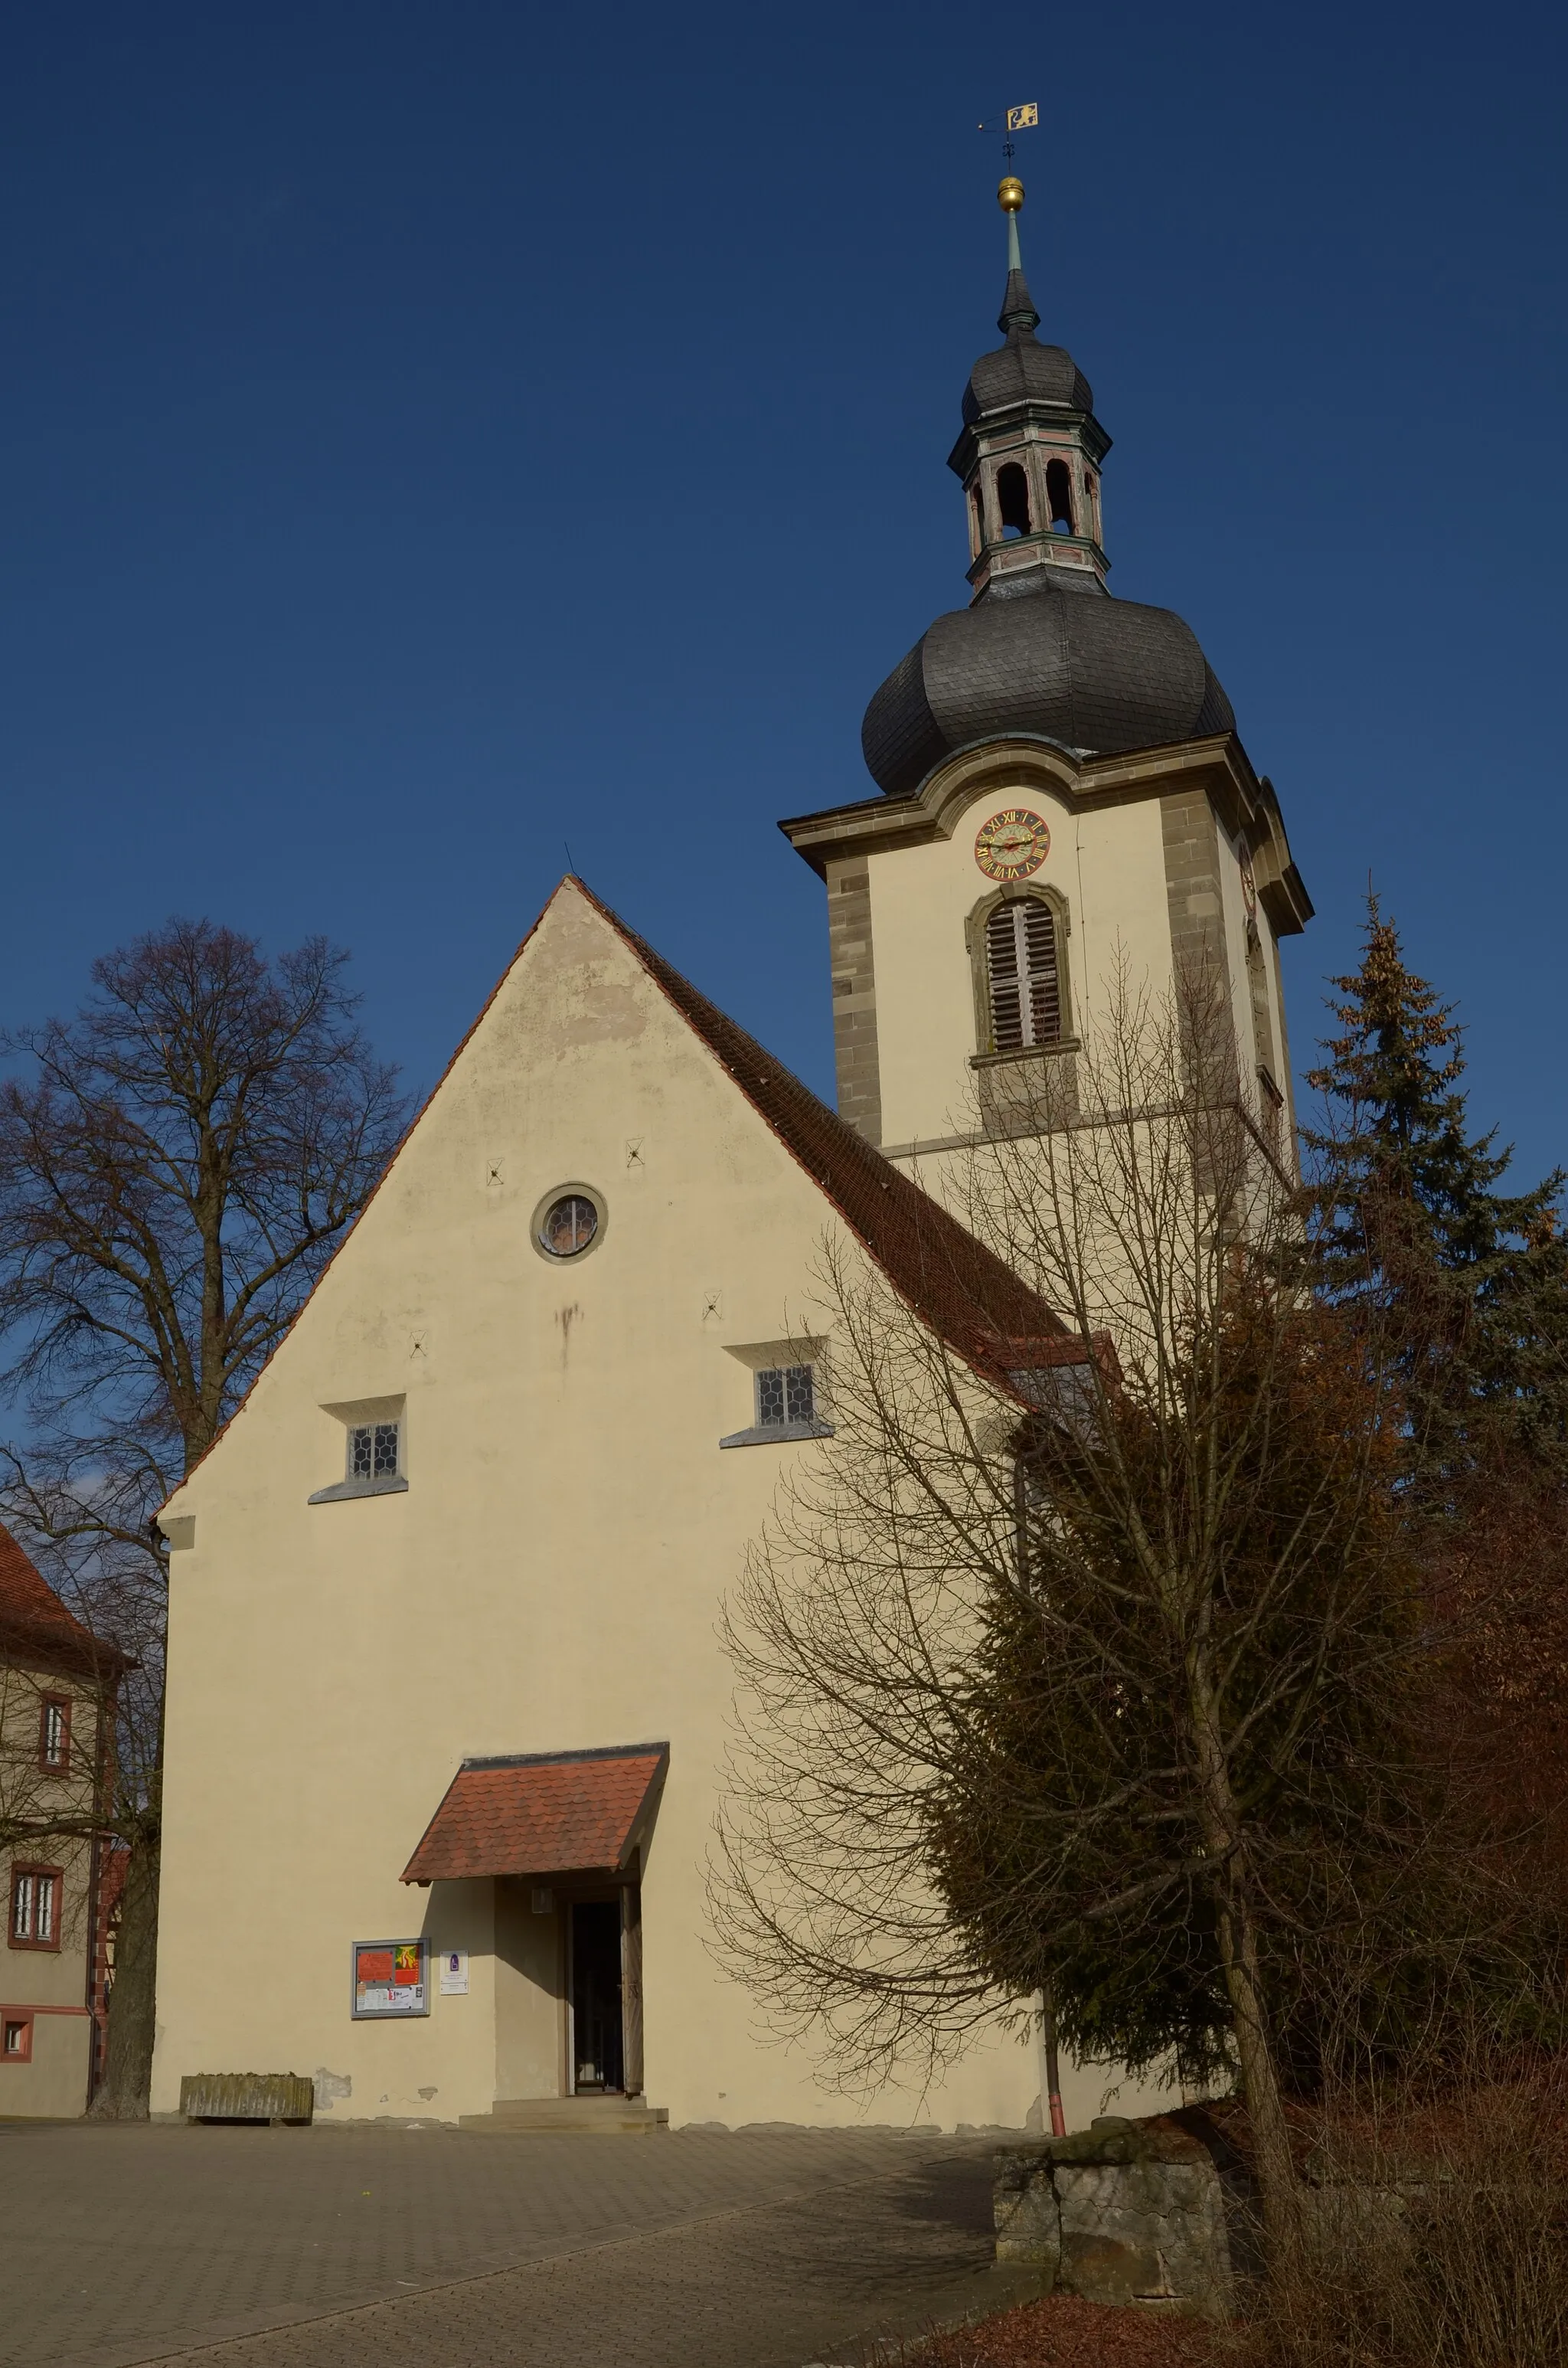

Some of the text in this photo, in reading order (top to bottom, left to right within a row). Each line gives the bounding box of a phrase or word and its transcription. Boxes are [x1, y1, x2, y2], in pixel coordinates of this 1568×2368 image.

[1002, 811, 1016, 823] XII
[987, 817, 1001, 832] XI
[1031, 820, 1042, 830] II
[1037, 834, 1048, 842] III
[977, 848, 988, 857] IX
[1032, 848, 1046, 859] IIII
[1026, 862, 1036, 872] V
[1008, 867, 1019, 878] VI
